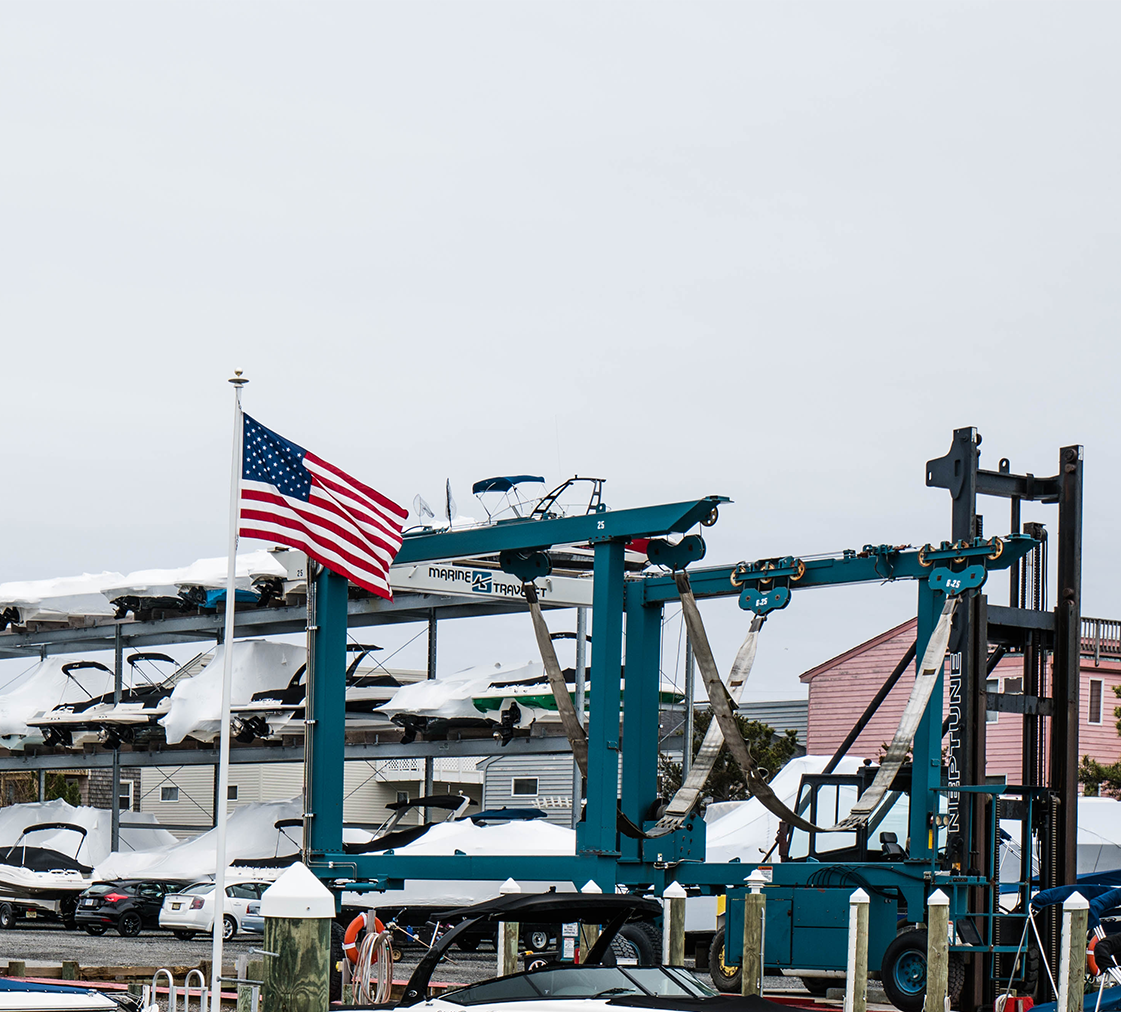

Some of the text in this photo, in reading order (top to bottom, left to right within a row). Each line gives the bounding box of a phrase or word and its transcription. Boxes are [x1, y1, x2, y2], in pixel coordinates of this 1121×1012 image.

[597, 520, 605, 530] 25
[296, 569, 304, 577] 25
[429, 567, 471, 583] MARINE
[947, 651, 962, 833] NEPTUNE
